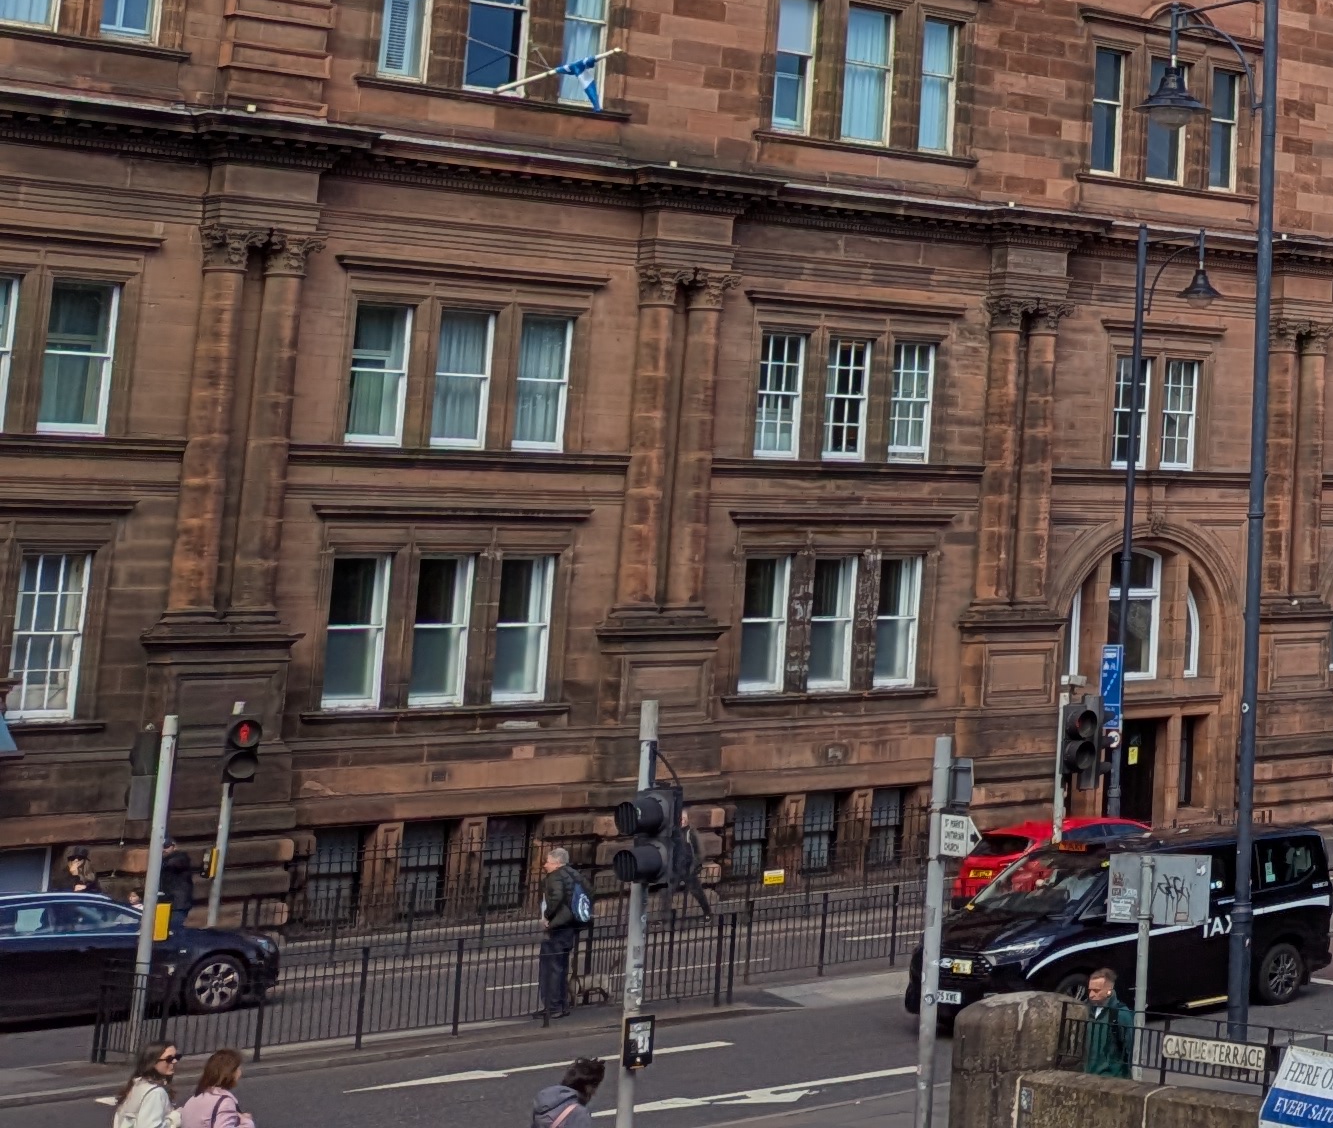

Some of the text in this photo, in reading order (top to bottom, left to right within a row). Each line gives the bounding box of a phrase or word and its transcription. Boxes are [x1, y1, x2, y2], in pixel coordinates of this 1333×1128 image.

[1164, 1037, 1263, 1068] CASTLE TERRACE
[1283, 1060, 1323, 1087] HERE
[1273, 1097, 1313, 1118] EVERY
